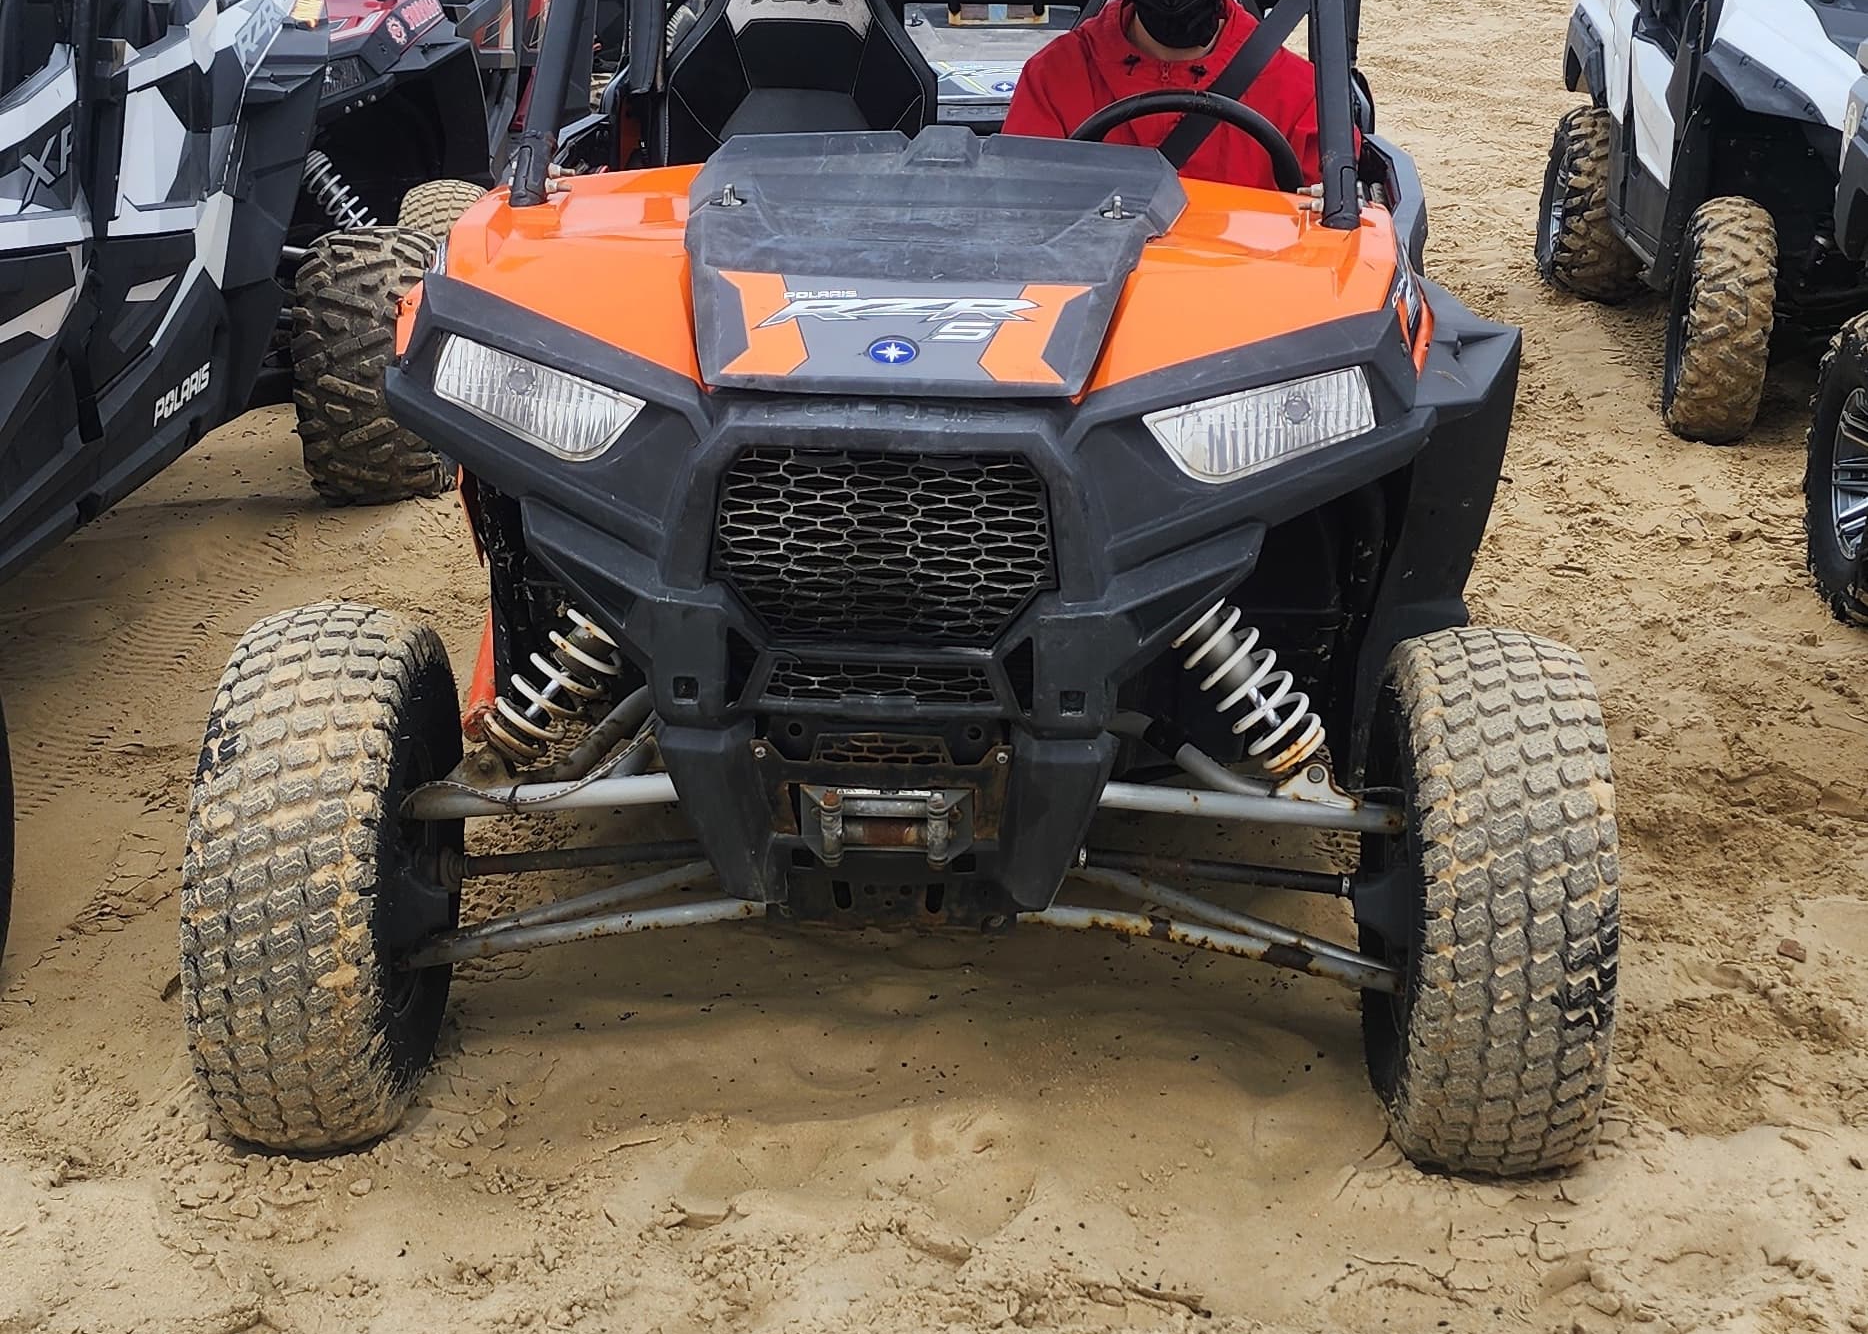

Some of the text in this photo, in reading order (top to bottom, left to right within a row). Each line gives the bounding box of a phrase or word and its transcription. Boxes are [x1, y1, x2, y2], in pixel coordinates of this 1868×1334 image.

[783, 290, 858, 299] POLARIS
[752, 298, 1042, 329] RZR
[922, 320, 1000, 343] S
[153, 361, 211, 427] POLARIS
